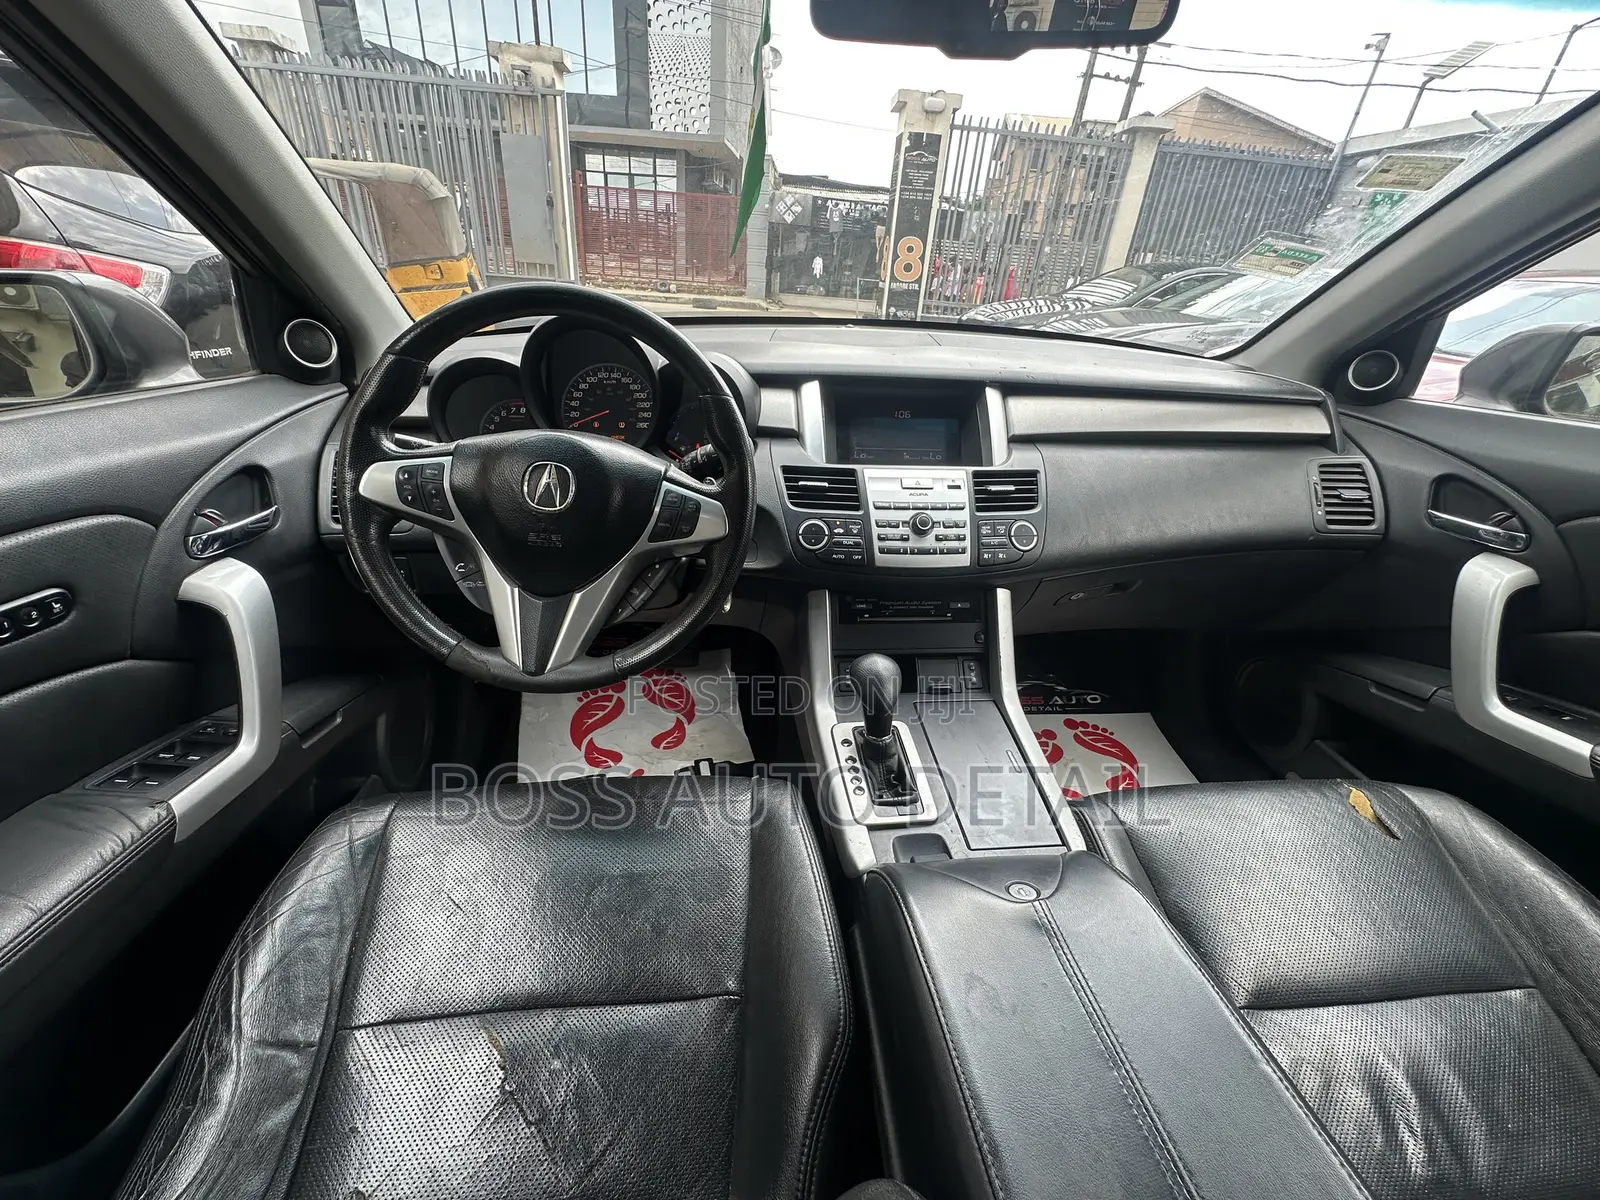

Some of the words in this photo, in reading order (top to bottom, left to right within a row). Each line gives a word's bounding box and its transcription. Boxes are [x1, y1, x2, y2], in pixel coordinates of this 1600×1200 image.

[894, 236, 923, 282] 8
[31, 611, 38, 619] 2
[1048, 694, 1102, 705] AUTO
